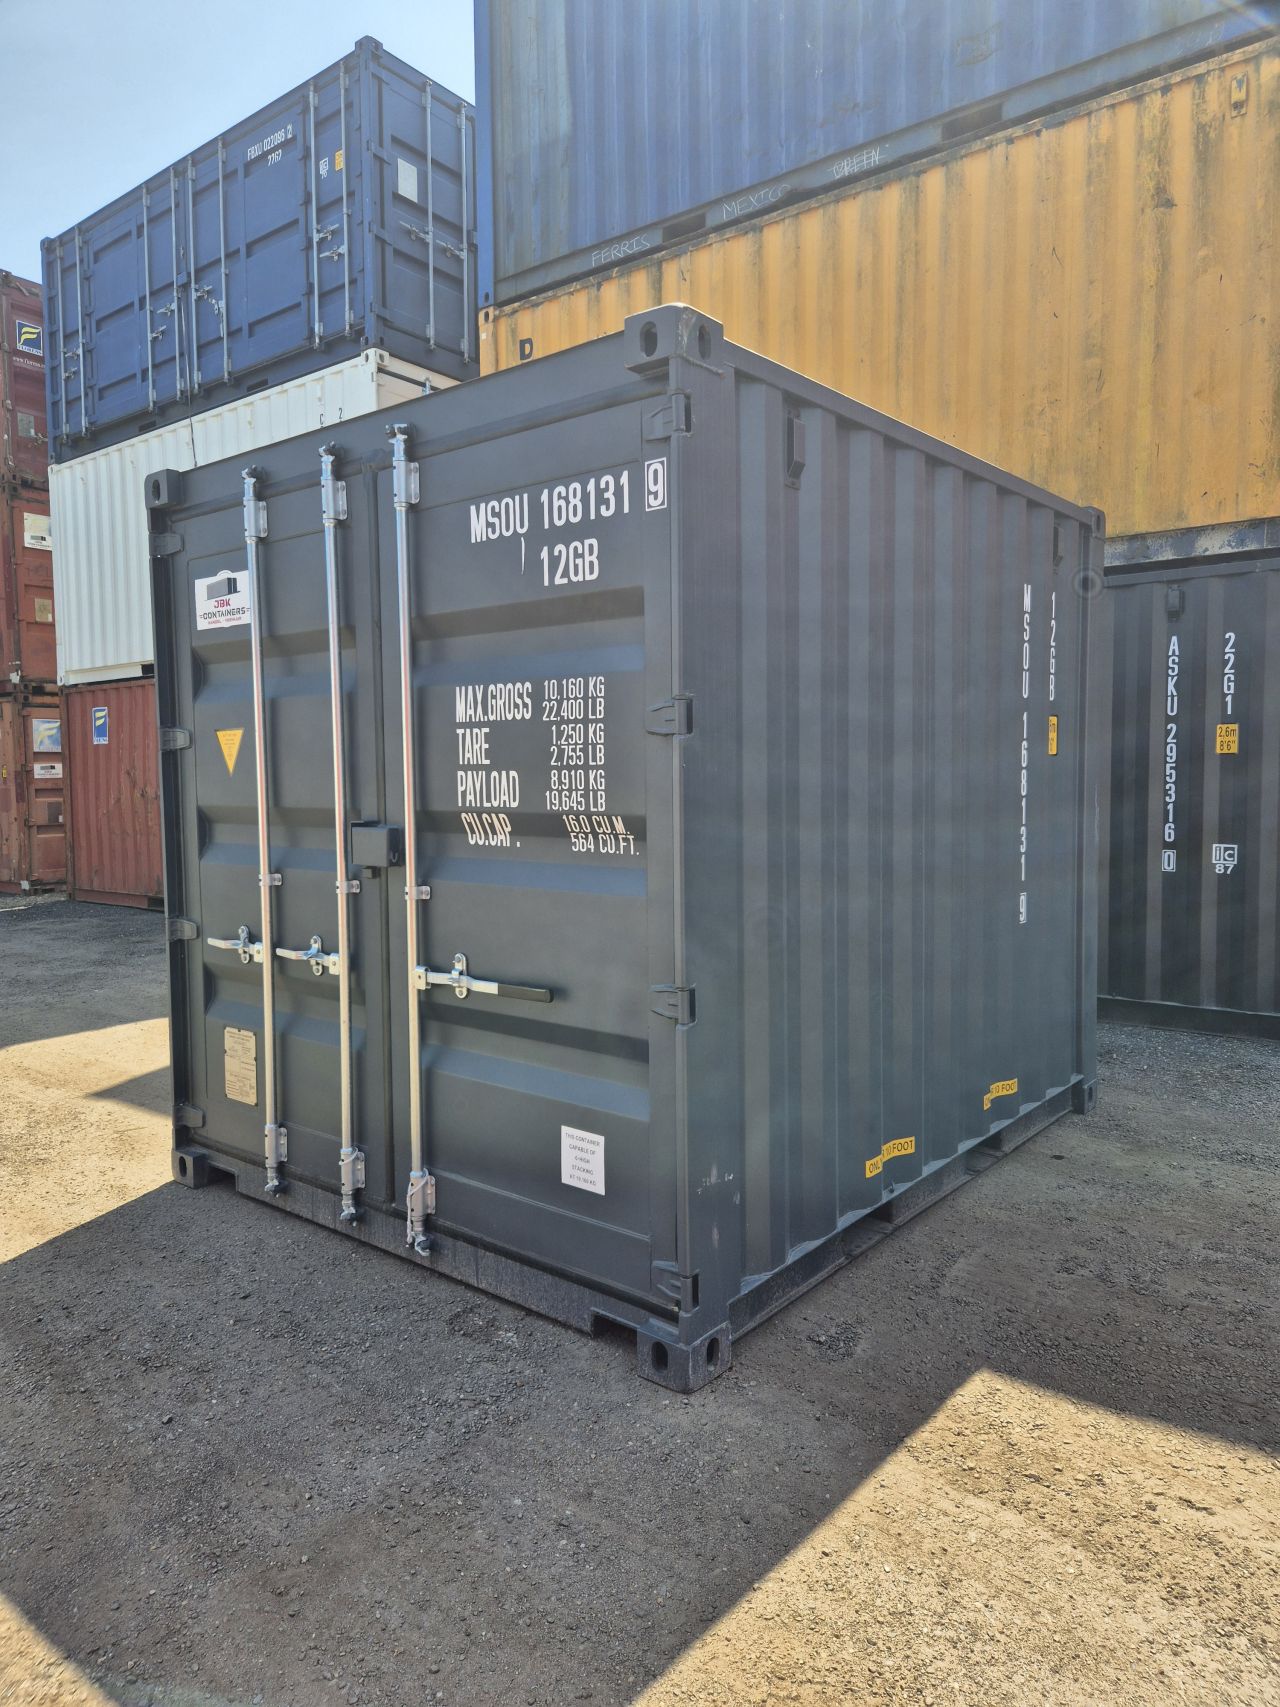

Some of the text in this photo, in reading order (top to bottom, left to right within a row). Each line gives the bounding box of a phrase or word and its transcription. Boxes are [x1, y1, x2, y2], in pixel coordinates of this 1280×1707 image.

[591, 234, 650, 268] FERRIS
[470, 460, 666, 543] MSOU 168131 9
[540, 537, 600, 586] 12GB
[202, 606, 246, 620] CONTAINERS
[213, 598, 231, 609] JBK
[1022, 583, 1031, 699] MSOU
[1166, 635, 1180, 716] ASKU
[1223, 631, 1236, 715] 22G1
[455, 676, 605, 723] MAX.GROSS 10,160 KG
[542, 698, 605, 721] 22,400 LB
[456, 727, 491, 765] TARE
[588, 723, 605, 744] KG
[550, 745, 605, 766] 2,755 LB
[457, 769, 606, 808] PAYLOAD 8,910 KG
[1020, 711, 1029, 882] 168131
[1164, 723, 1177, 842] 295316
[545, 791, 606, 812] 19,645 LB
[562, 814, 591, 833] 16.0
[570, 832, 595, 853] 564
[1163, 851, 1175, 871] 0
[1215, 864, 1234, 875] 87
[1019, 893, 1027, 923] 9
[892, 1139, 913, 1154] FOOT
